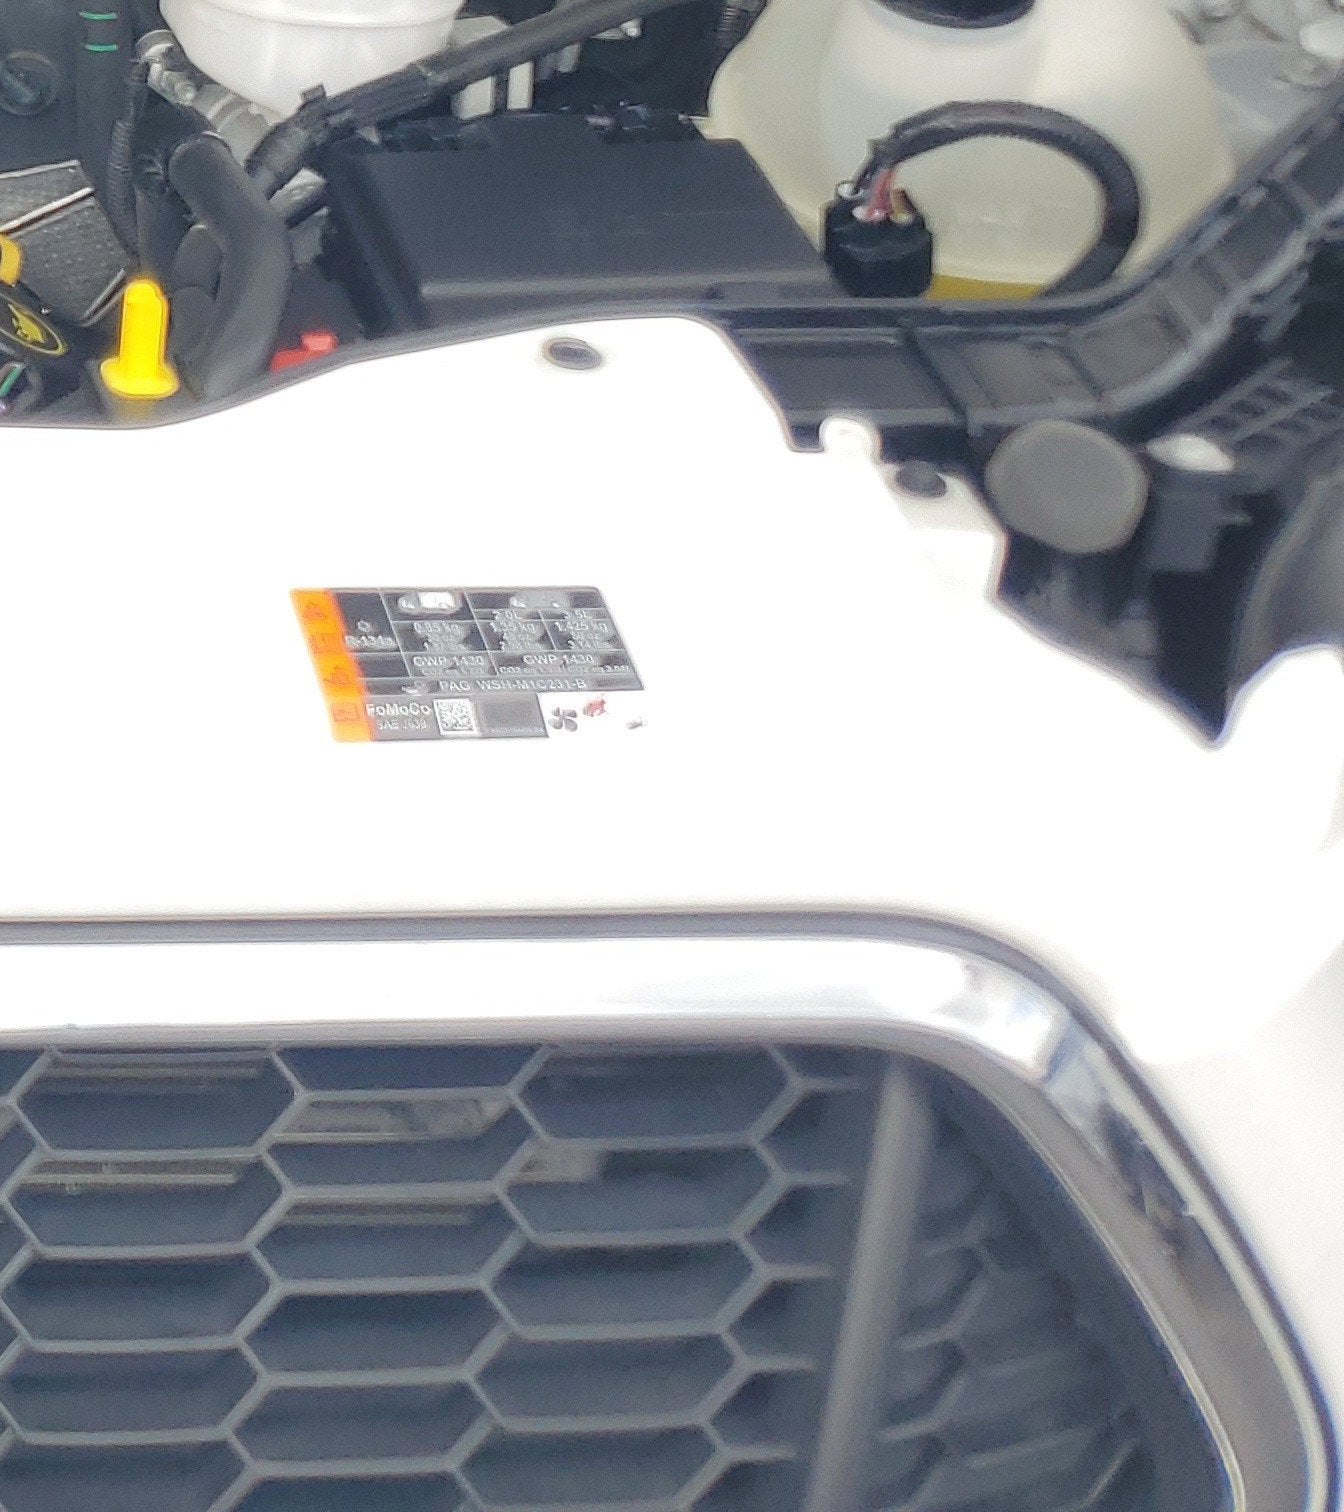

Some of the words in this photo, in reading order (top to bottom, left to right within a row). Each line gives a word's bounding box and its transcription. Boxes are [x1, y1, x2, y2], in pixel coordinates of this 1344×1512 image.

[520, 622, 537, 633] kg
[554, 621, 588, 632] 1.425
[591, 622, 609, 634] kg
[413, 656, 447, 667] GWP
[452, 656, 485, 666] 1430
[523, 655, 558, 665] GWP
[562, 655, 595, 664] 1430
[439, 680, 471, 692] PAG
[477, 679, 587, 691] WSH-M1C231-B
[366, 703, 432, 717] FoMoCo
[377, 719, 400, 731] SAE
